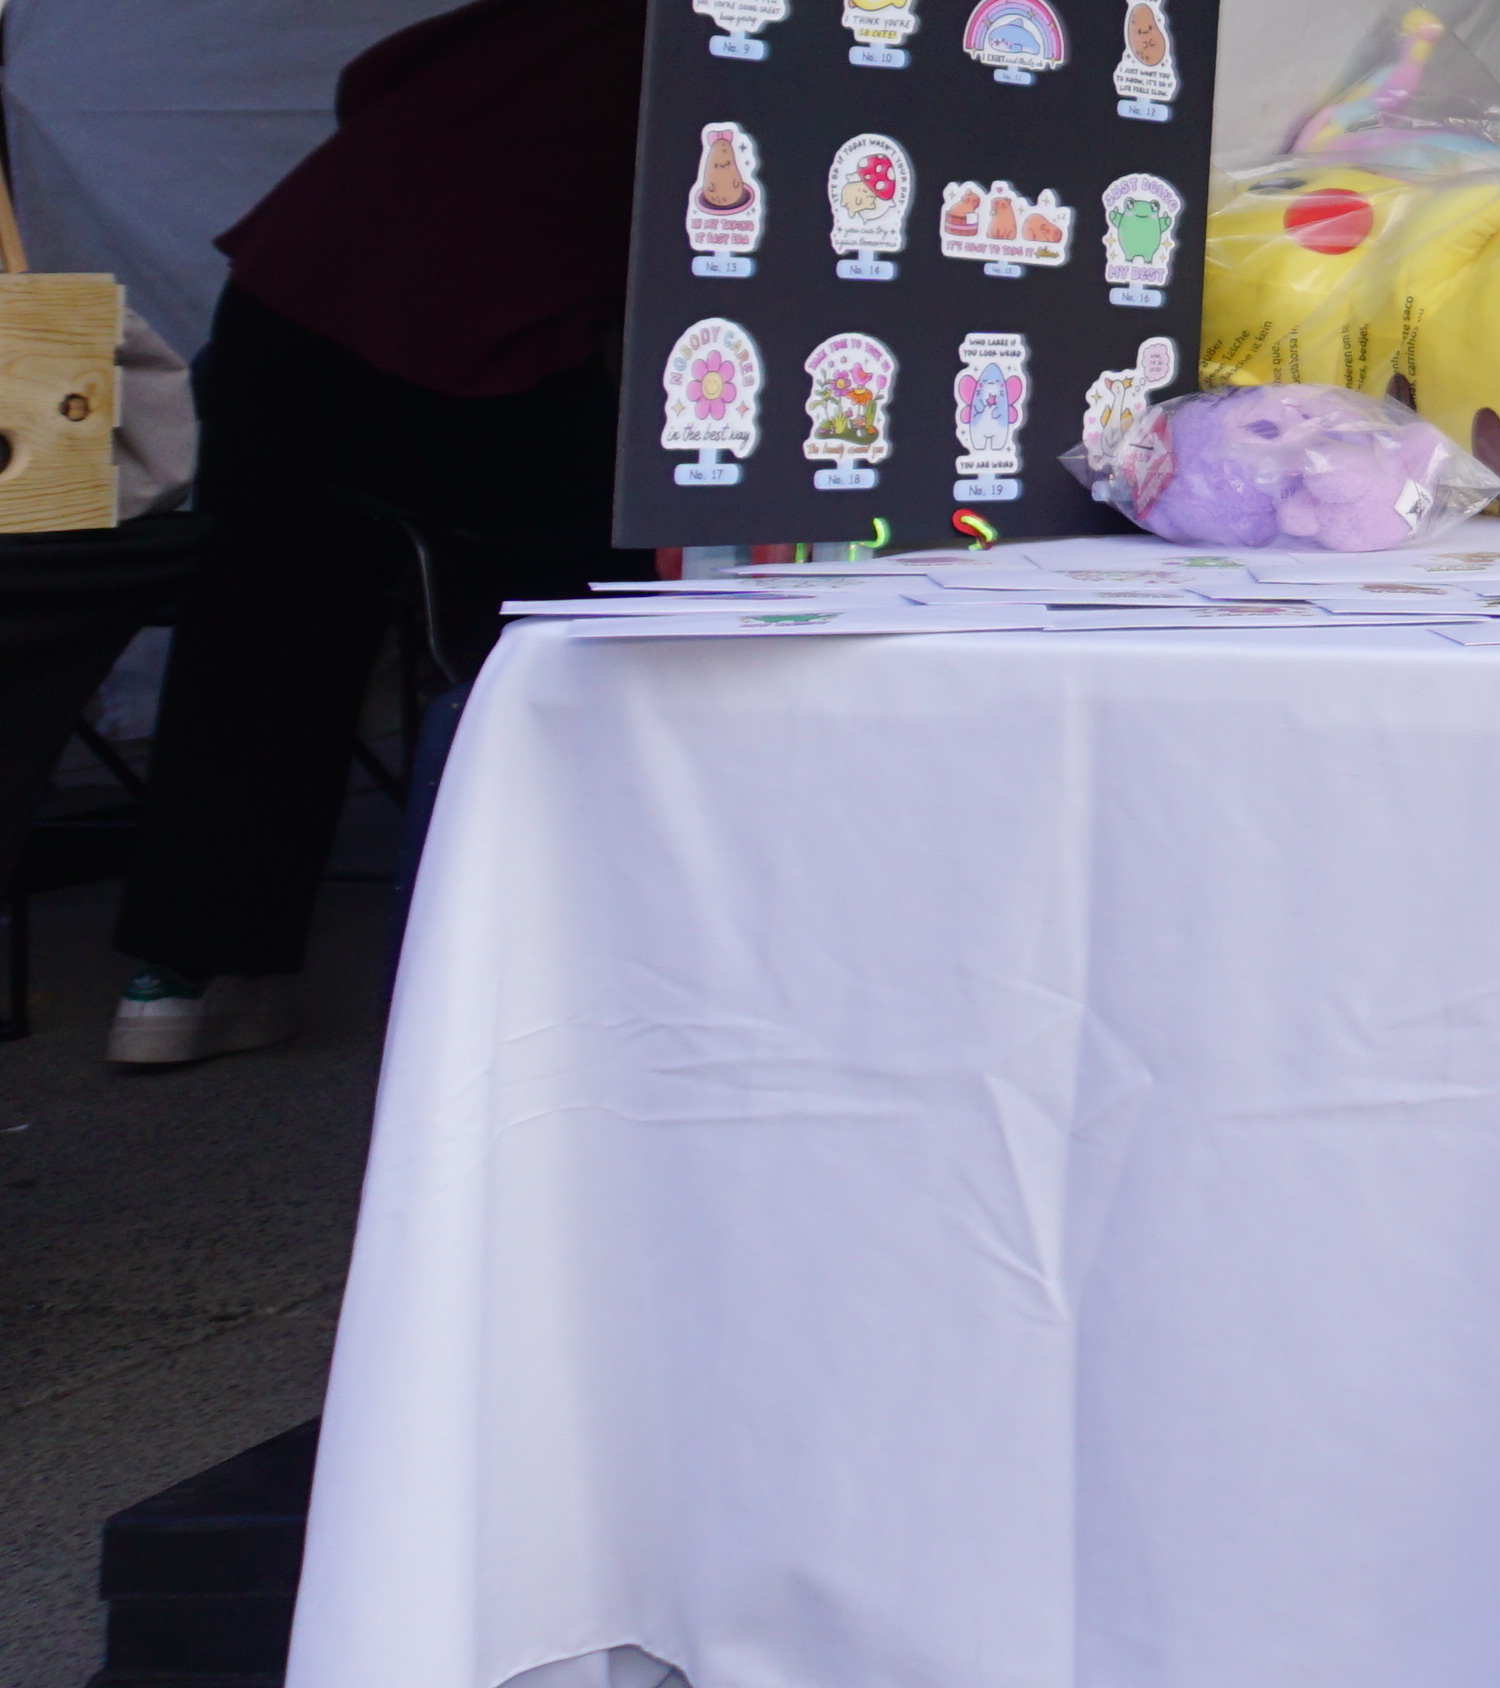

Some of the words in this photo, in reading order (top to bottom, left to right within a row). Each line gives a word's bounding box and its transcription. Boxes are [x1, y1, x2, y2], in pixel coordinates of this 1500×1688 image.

[1105, 177, 1139, 207] JUST
[1141, 178, 1179, 212] DOING
[1108, 265, 1128, 279] MY
[1131, 266, 1165, 282] BEST
[1403, 296, 1414, 321] saco
[969, 338, 986, 346] WHO
[669, 325, 721, 386] NOBODY
[723, 330, 755, 387] CARES
[963, 349, 978, 357] YOU
[979, 349, 997, 357] LOOK
[666, 426, 680, 442] in
[682, 424, 701, 441] the
[703, 425, 728, 441] best
[728, 430, 750, 451] way
[960, 461, 975, 469] YOU
